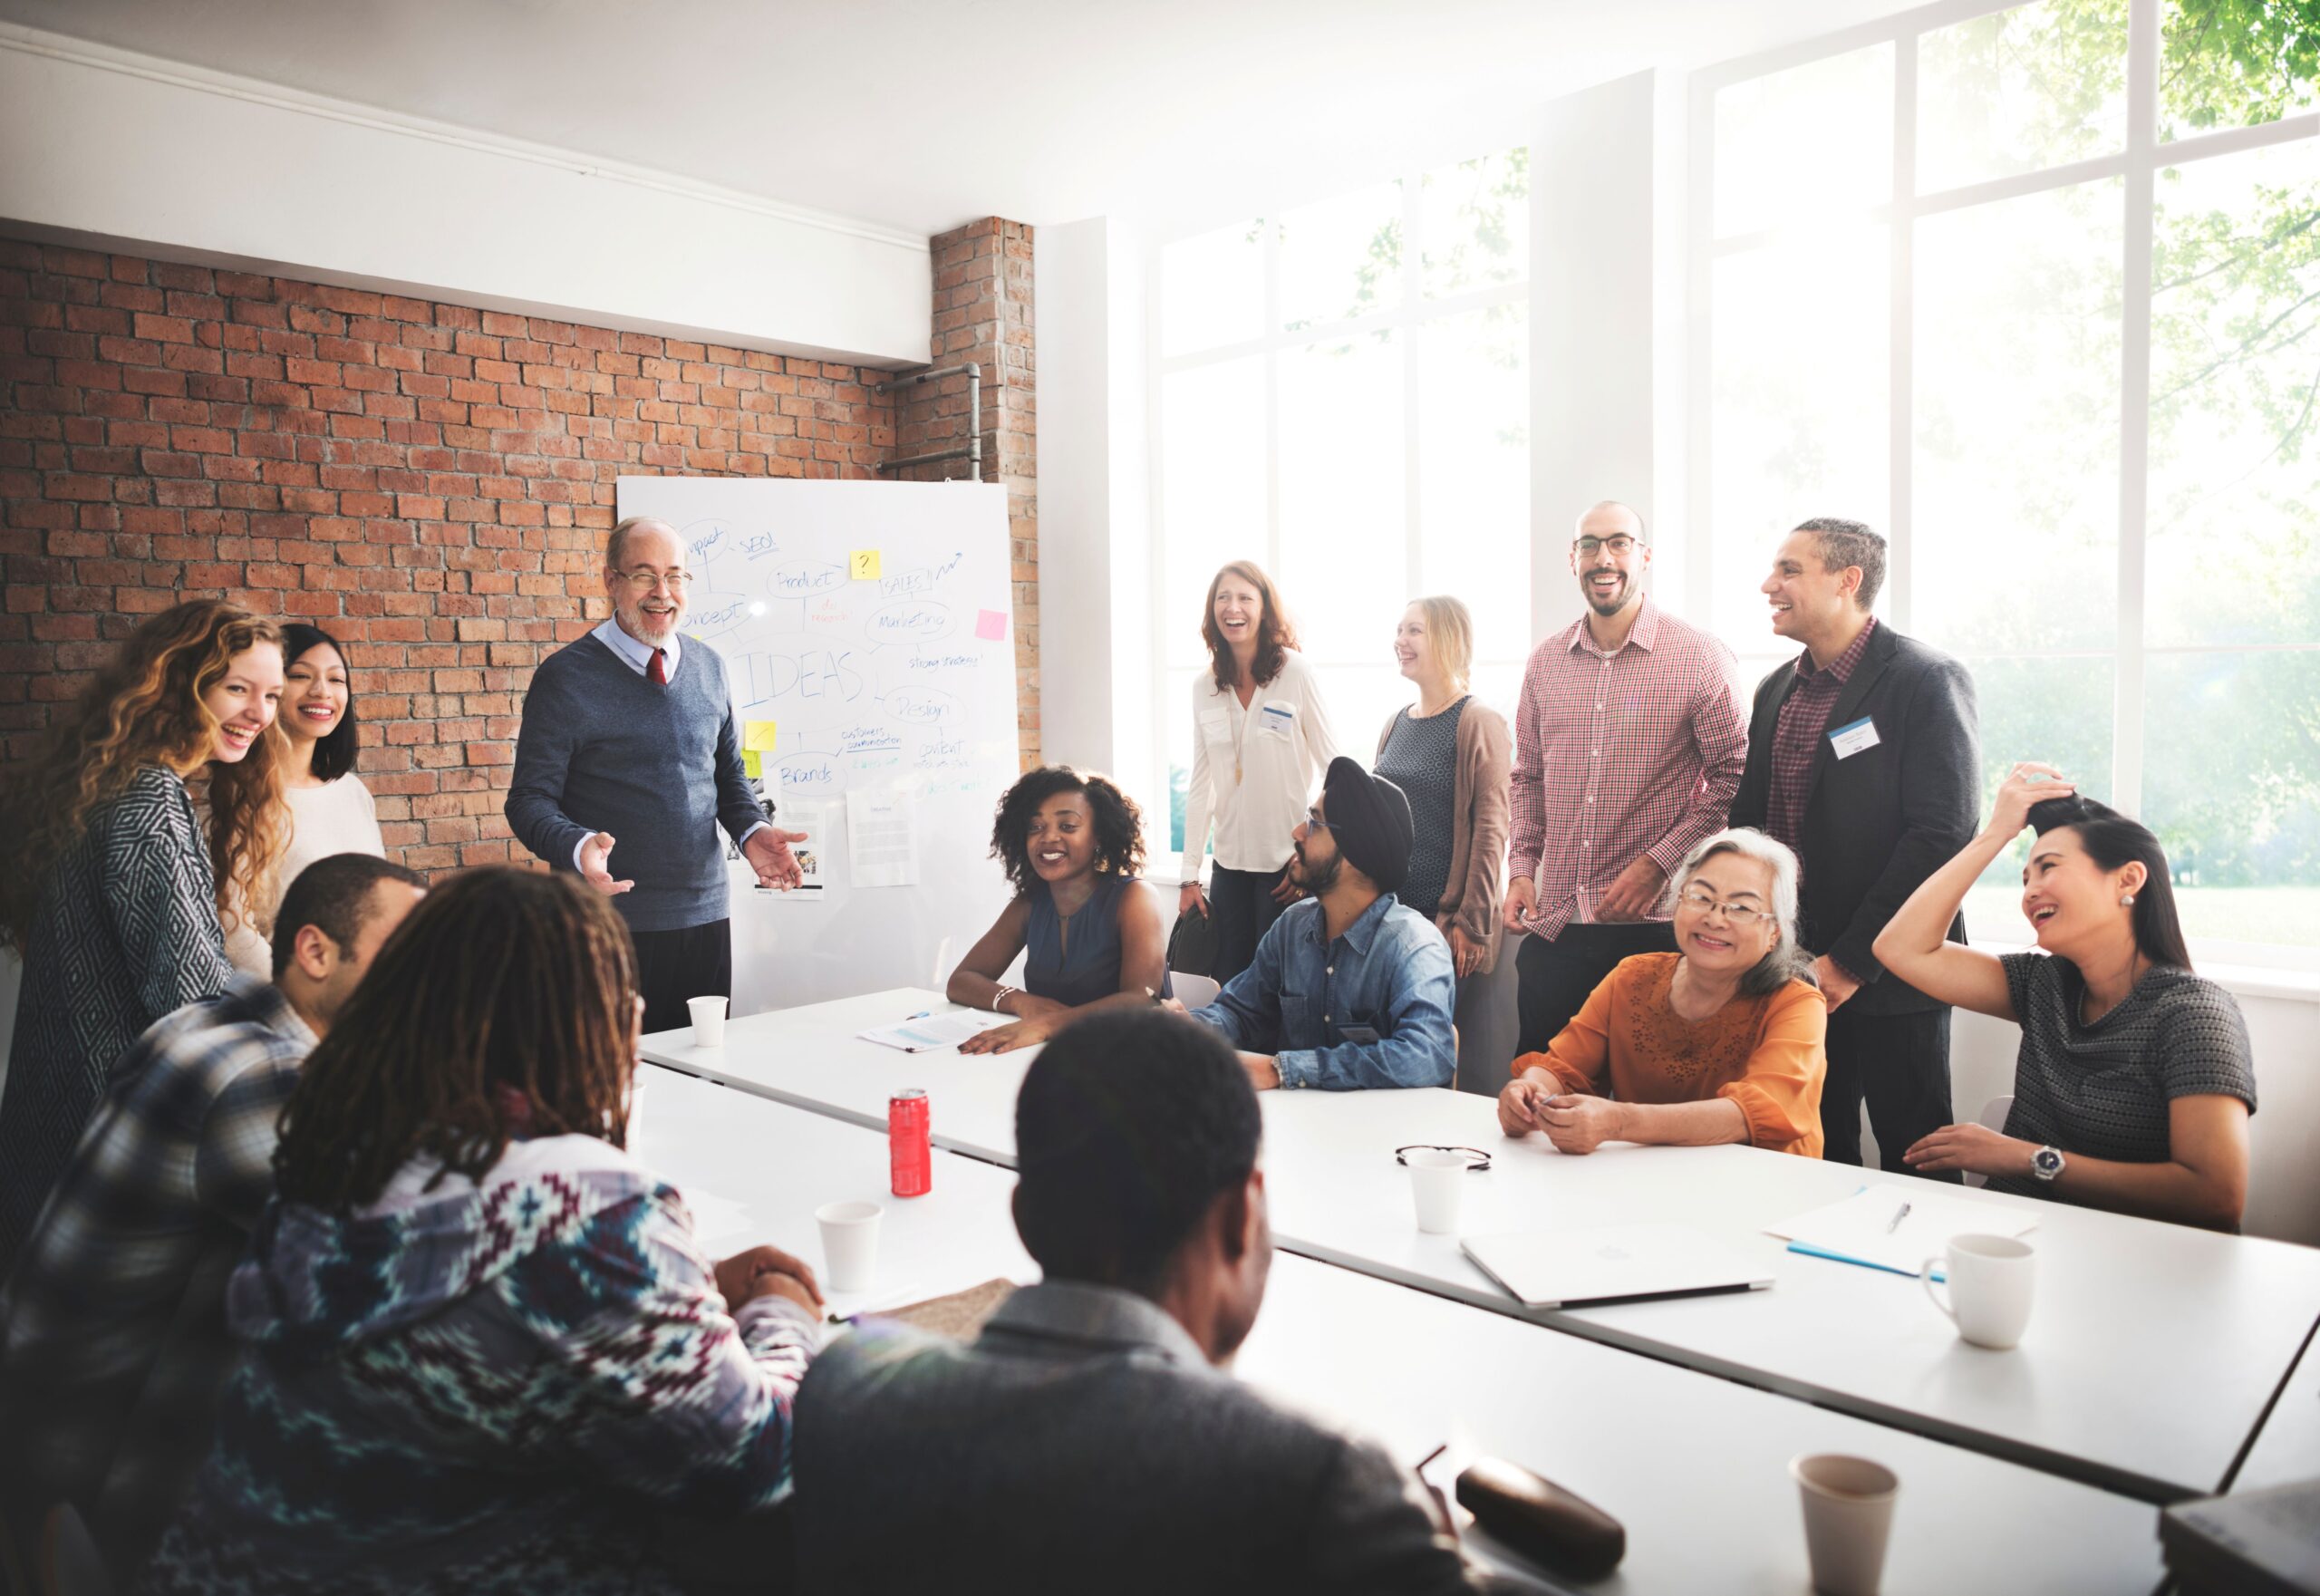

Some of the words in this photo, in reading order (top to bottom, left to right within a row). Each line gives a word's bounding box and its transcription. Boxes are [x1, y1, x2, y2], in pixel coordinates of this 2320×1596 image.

[689, 526, 724, 556] mpact
[859, 555, 869, 575] ?
[777, 571, 834, 588] Product
[682, 601, 744, 628] oncept
[879, 609, 945, 634] Marketing
[734, 651, 863, 708] IDEAS
[896, 697, 949, 723] Design
[781, 762, 833, 787] Brands
